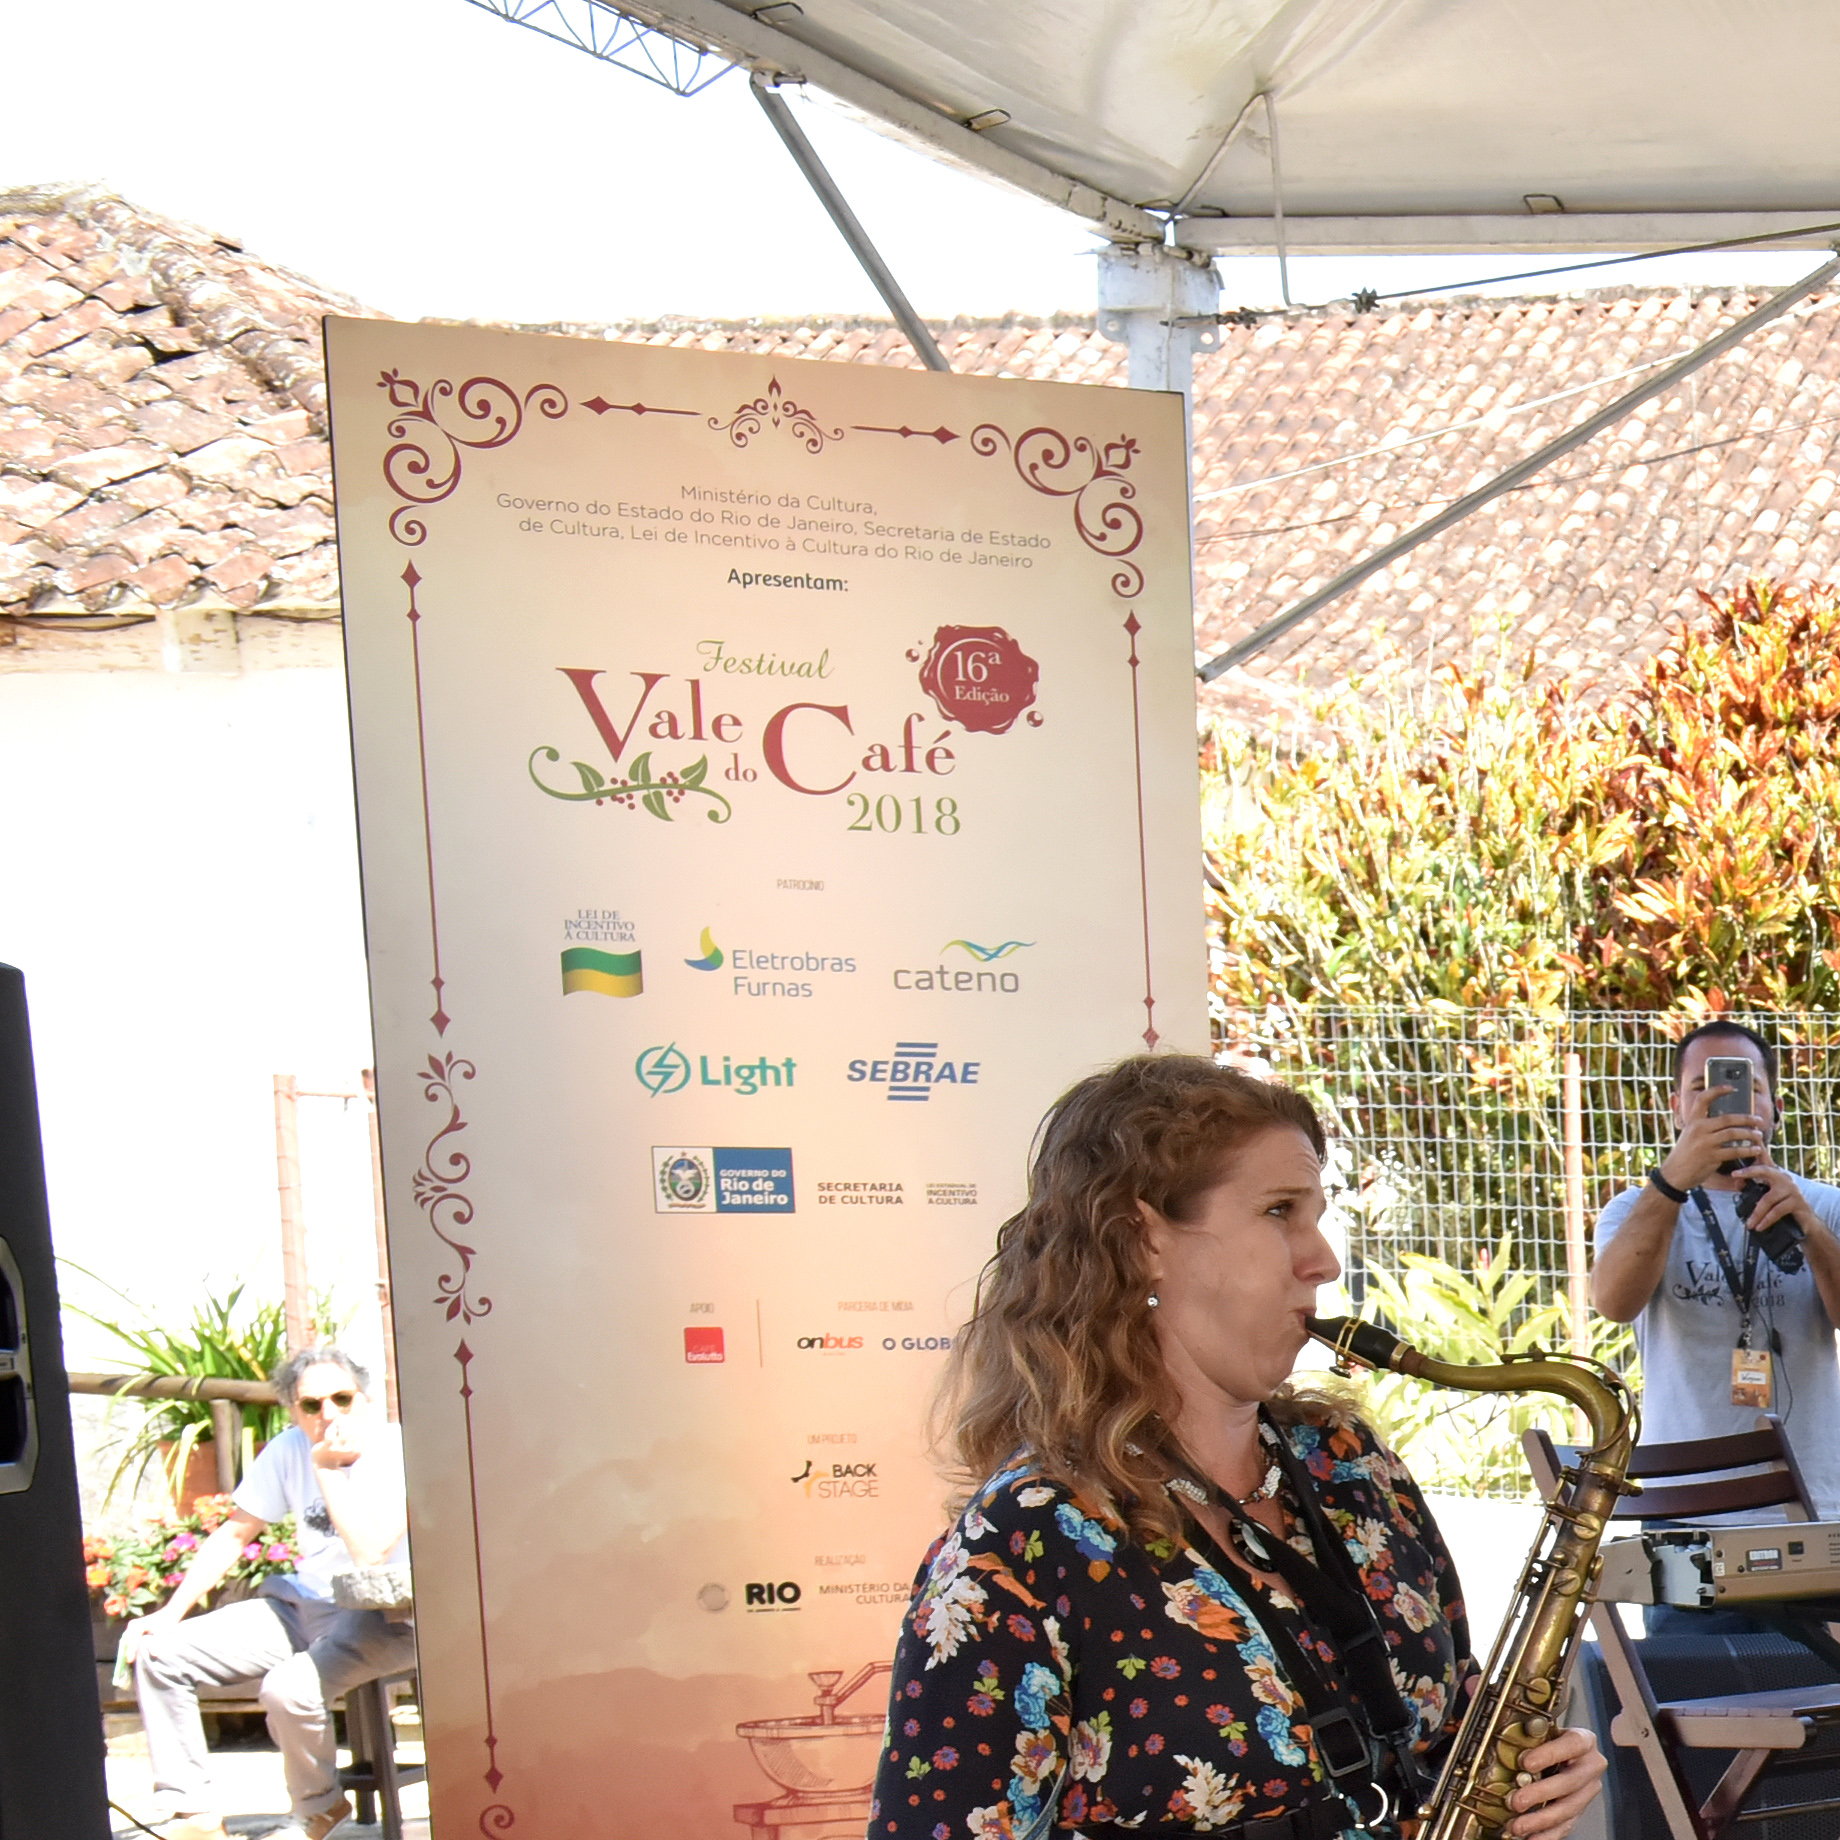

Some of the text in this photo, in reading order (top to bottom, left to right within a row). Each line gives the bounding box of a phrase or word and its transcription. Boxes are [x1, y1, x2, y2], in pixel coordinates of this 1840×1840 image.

[681, 485, 877, 515] Ministério da Cultura,
[496, 493, 1051, 549] Governo do Estado do Rio de Janeiro, Secretaria de Estado
[519, 517, 1033, 569] de Cultura, Lei de Incentivo à Cultura do Rio de Janeiro
[727, 568, 849, 592] Apresentam:
[696, 640, 835, 680] Festival
[954, 683, 1010, 704] Edição
[556, 667, 744, 763] Vale
[724, 702, 957, 796] do Café
[846, 792, 961, 836] 2018
[577, 909, 620, 920] LEI DE
[564, 919, 635, 931] INCENTIVO
[576, 931, 636, 942] CULTURA
[732, 949, 857, 973] Eletrobras
[733, 977, 813, 997] Furnas
[893, 965, 1019, 993] cateno
[699, 1055, 797, 1096] Light
[846, 1059, 981, 1084] SEBRAE
[719, 1169, 787, 1178] GOVERNO DO
[720, 1178, 775, 1191] Rio de
[817, 1182, 904, 1192] SECRETARIA
[721, 1192, 788, 1205] Janeiro
[818, 1195, 904, 1205] DE CULTURA
[797, 1332, 864, 1349] onbus
[882, 1337, 952, 1350] O GLOB
[832, 1463, 877, 1478] BACK
[818, 1480, 880, 1499] STAGE
[745, 1581, 801, 1605] RIO
[819, 1582, 910, 1595] MINISTÉRIO DA
[856, 1593, 910, 1605] CULTURA
